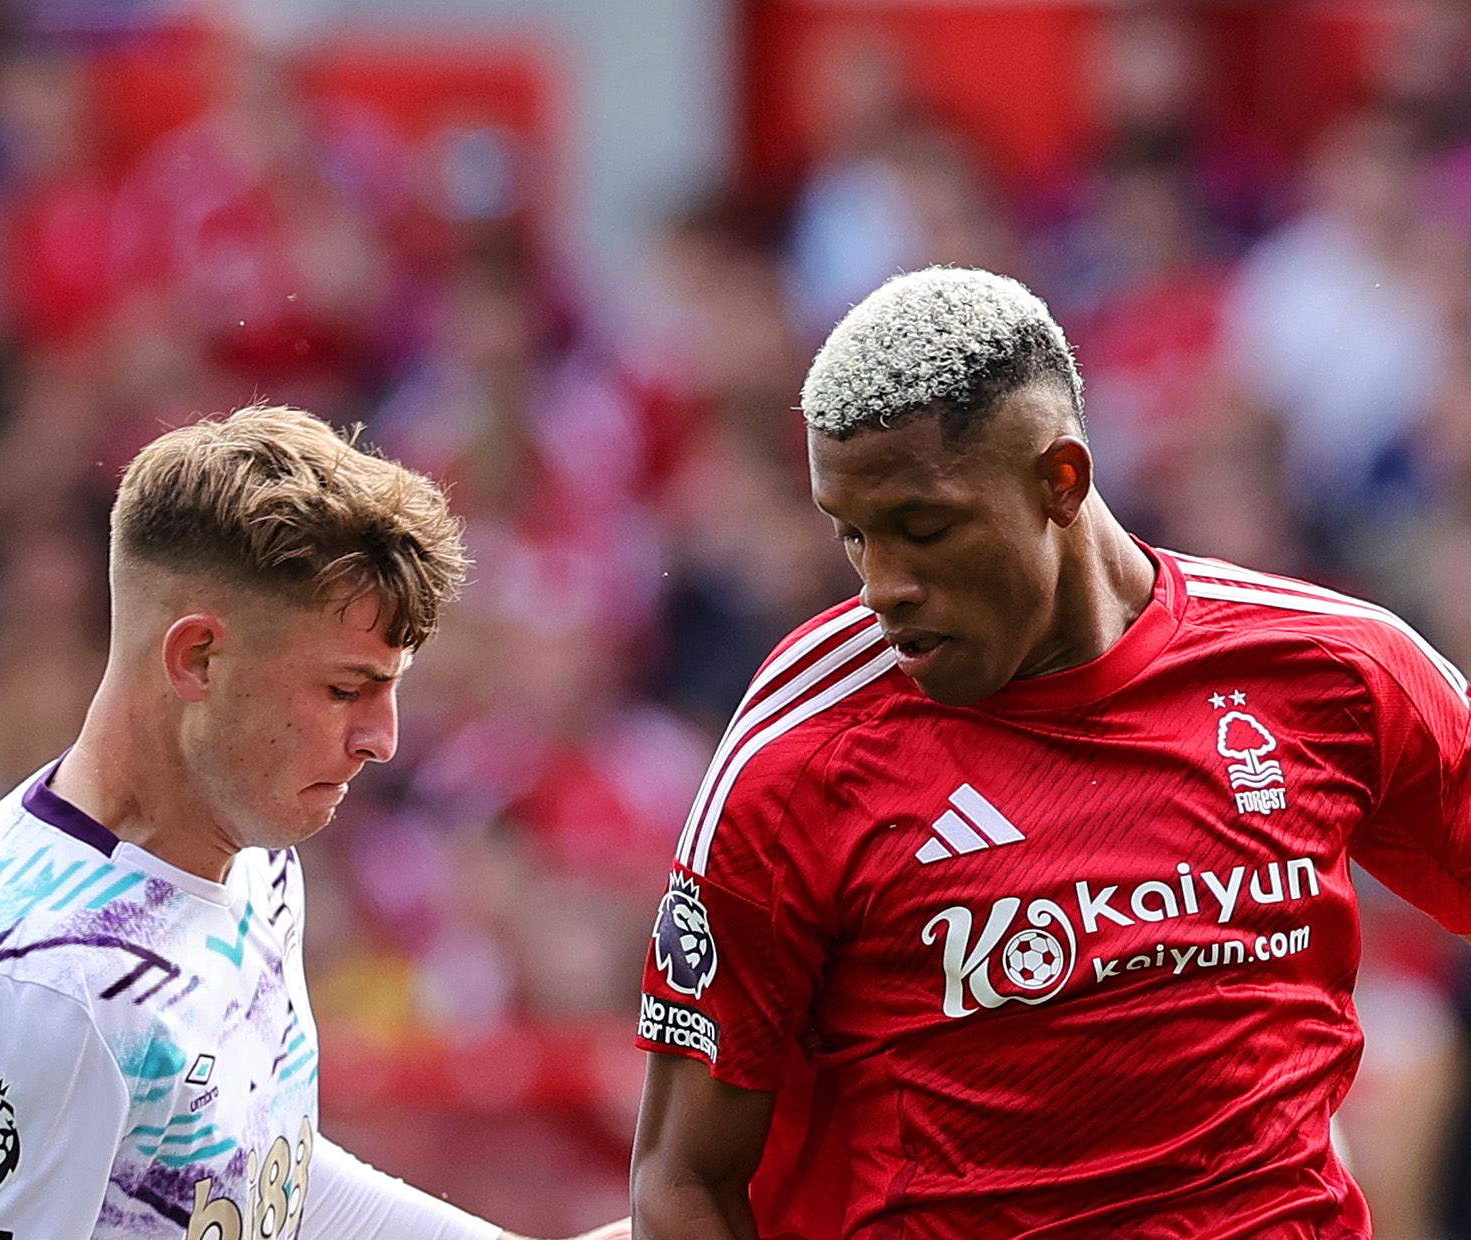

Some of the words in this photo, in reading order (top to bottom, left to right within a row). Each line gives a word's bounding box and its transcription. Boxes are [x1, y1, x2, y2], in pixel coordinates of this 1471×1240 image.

[1235, 788, 1286, 815] FOREST
[1075, 857, 1320, 934] kaiyun
[1091, 925, 1310, 983] kaiyun.com
[637, 1014, 663, 1041] for
[665, 1025, 717, 1064] racism
[640, 993, 666, 1021] No
[668, 1006, 715, 1041] room
